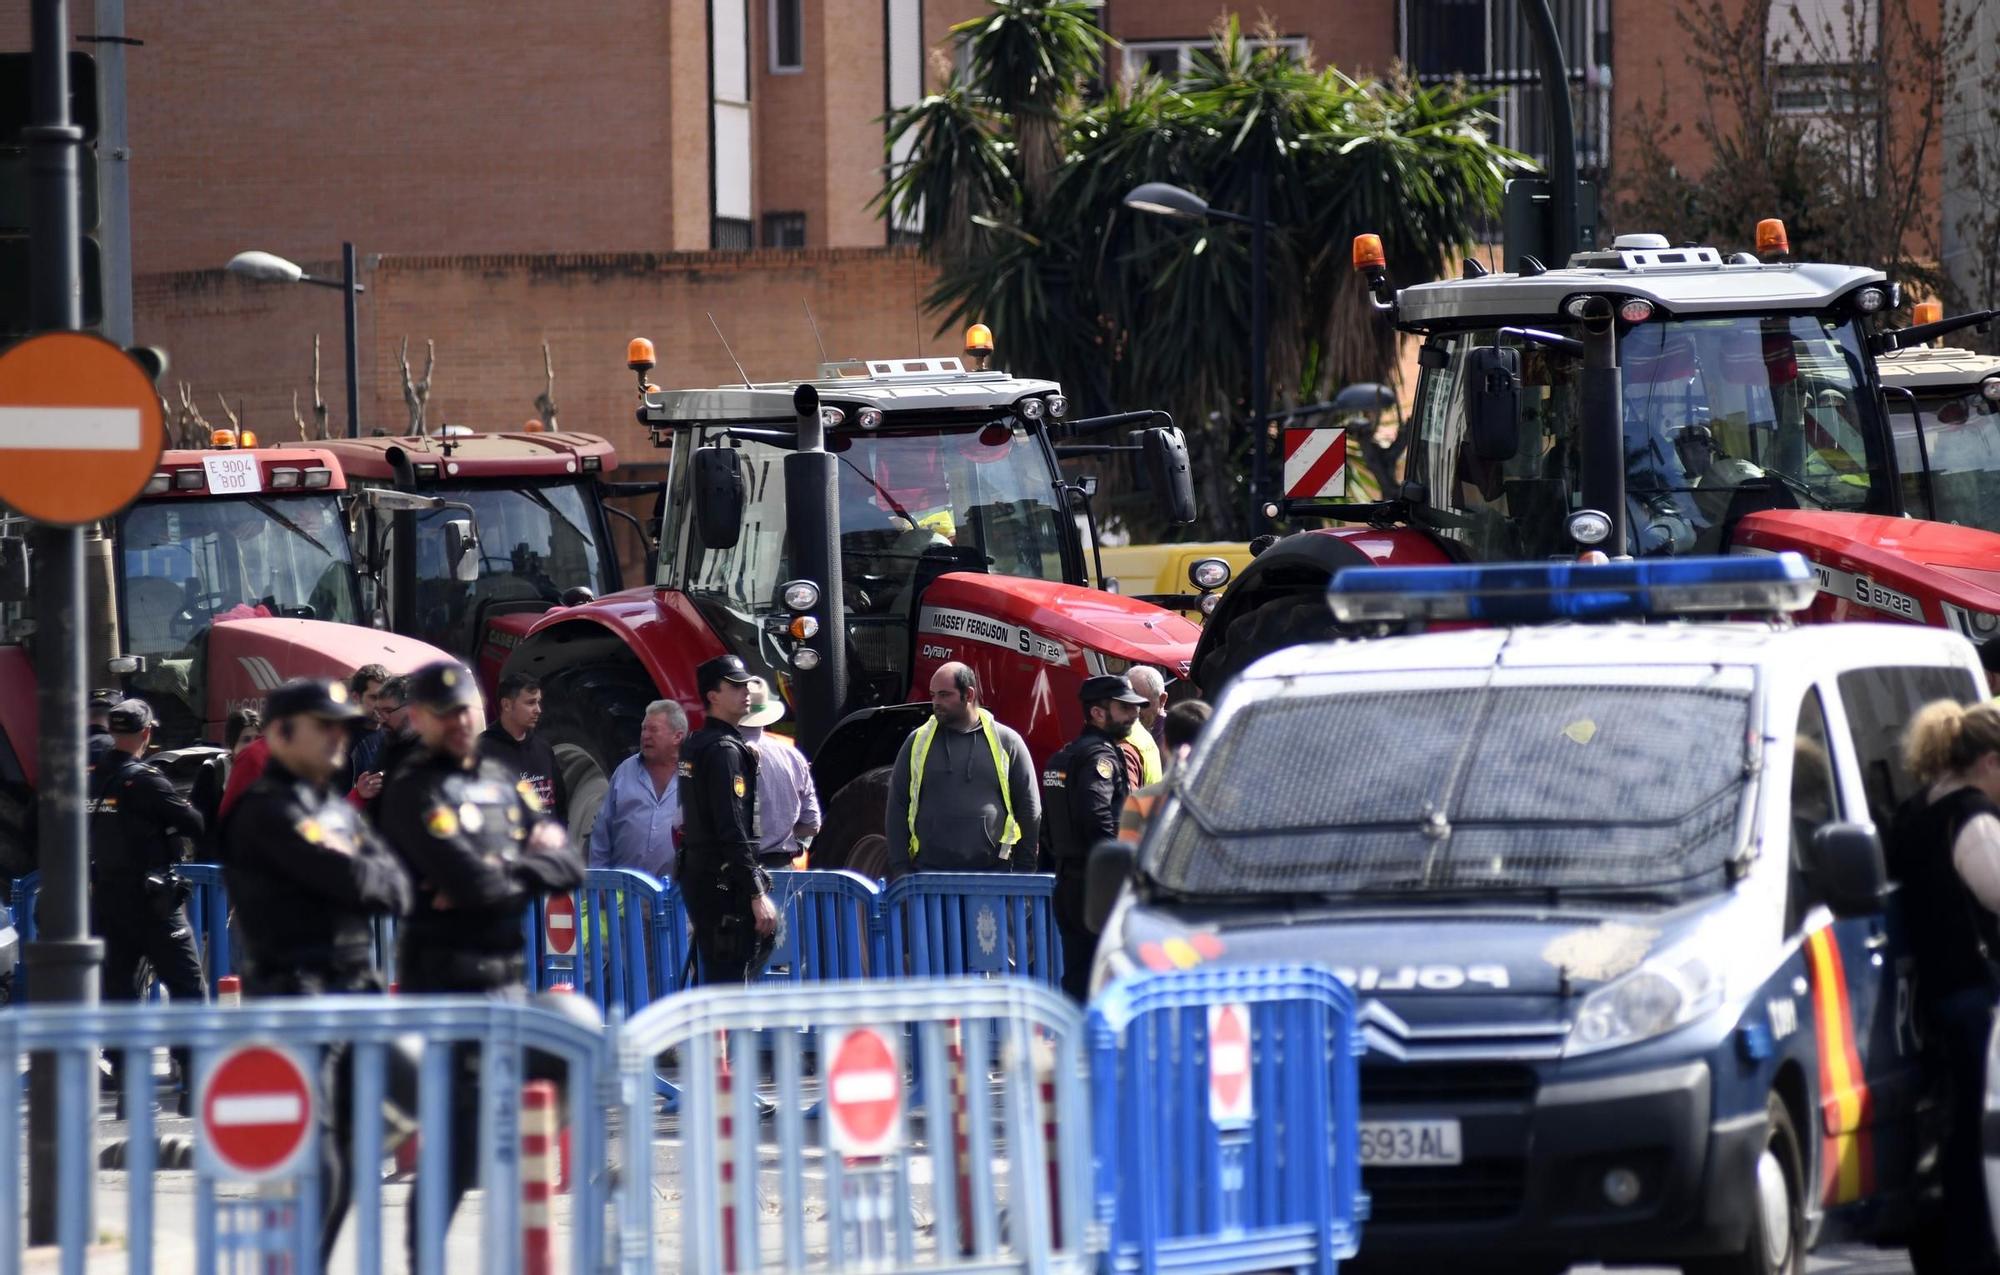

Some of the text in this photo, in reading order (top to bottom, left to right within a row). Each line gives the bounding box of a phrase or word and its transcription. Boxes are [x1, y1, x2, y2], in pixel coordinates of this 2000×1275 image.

[209, 460, 251, 474] E 9004
[1855, 577, 1870, 603] S
[1873, 588, 1913, 615] 8732
[932, 613, 1061, 658] MASSEY FERGUSON S 7724
